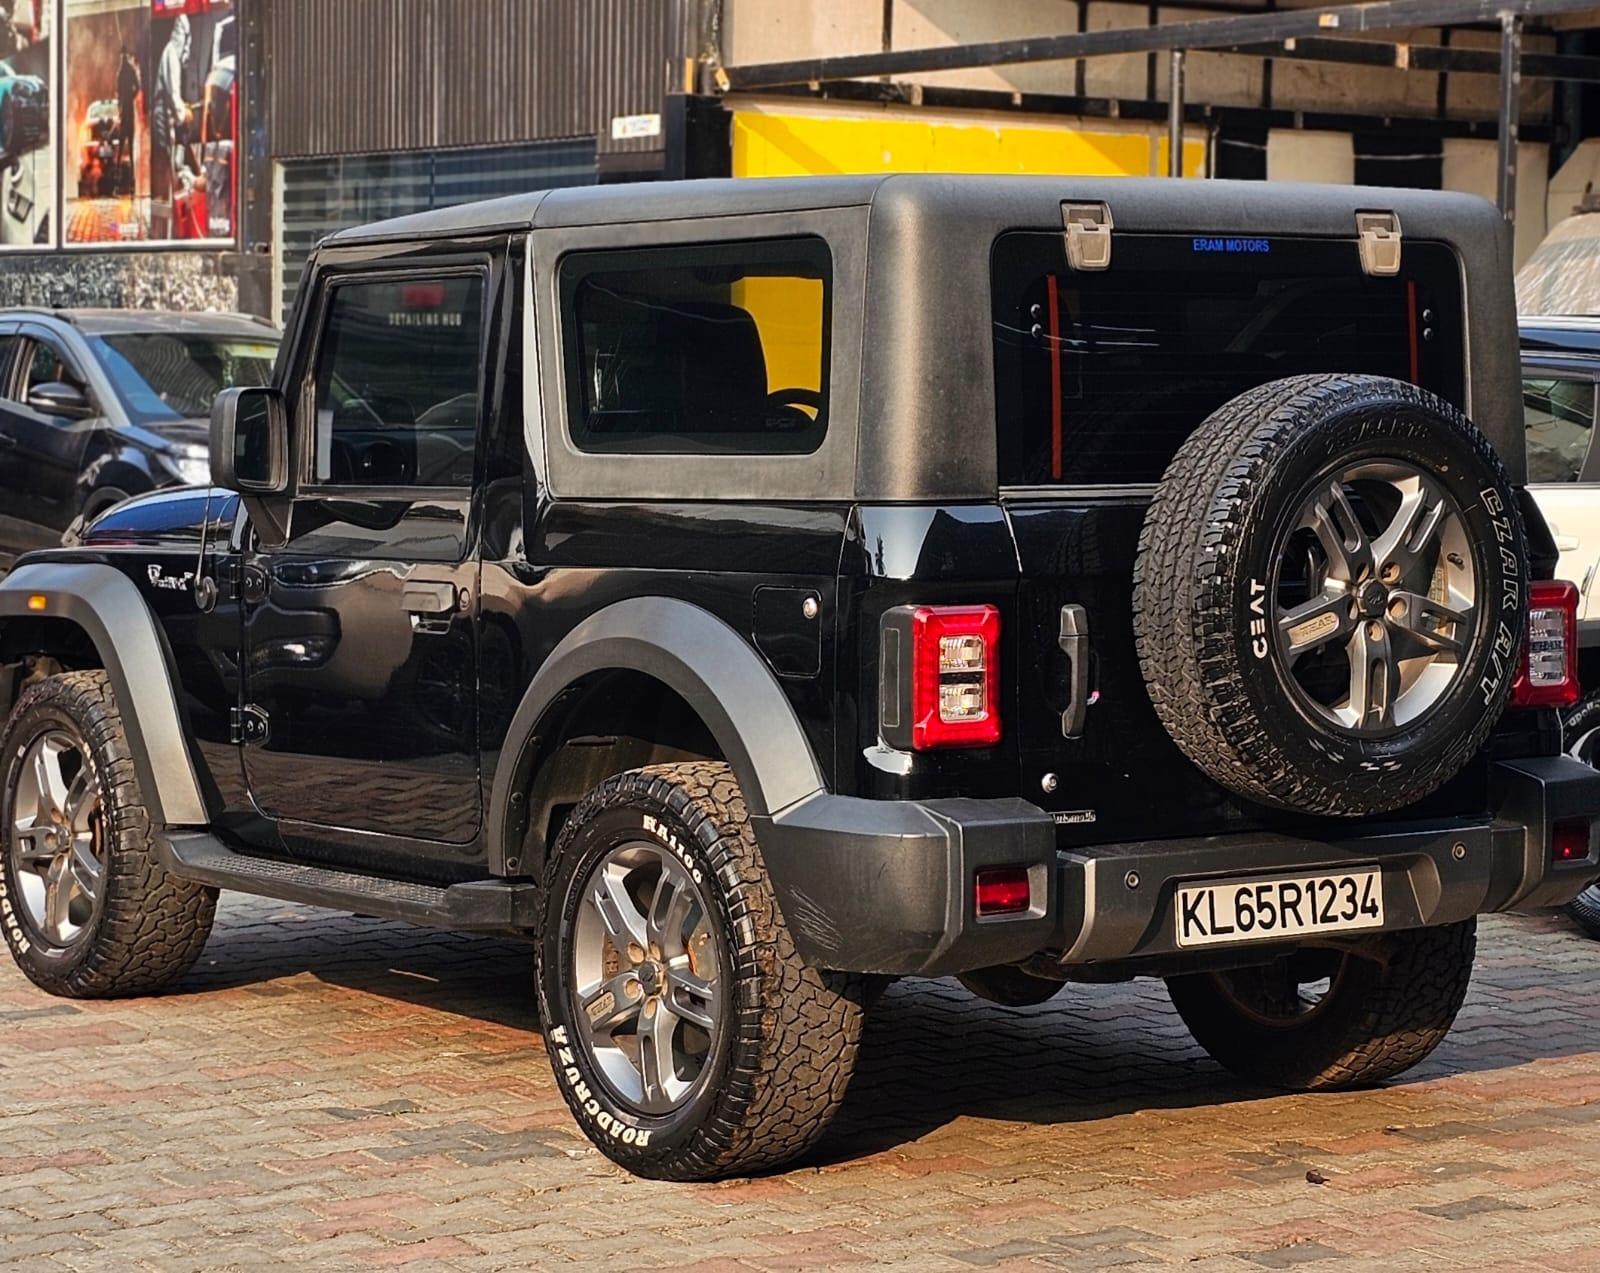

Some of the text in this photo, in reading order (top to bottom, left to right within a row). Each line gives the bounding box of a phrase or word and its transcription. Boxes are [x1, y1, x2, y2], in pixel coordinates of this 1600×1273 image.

[1193, 239, 1269, 253] ERAM MOTORS
[1250, 579, 1268, 659] CEAT
[1479, 486, 1519, 706] CZAR A/T
[643, 814, 702, 884] RA1100
[1182, 874, 1379, 938] KL65R1234
[550, 1024, 654, 1147] ROADCRUZA
